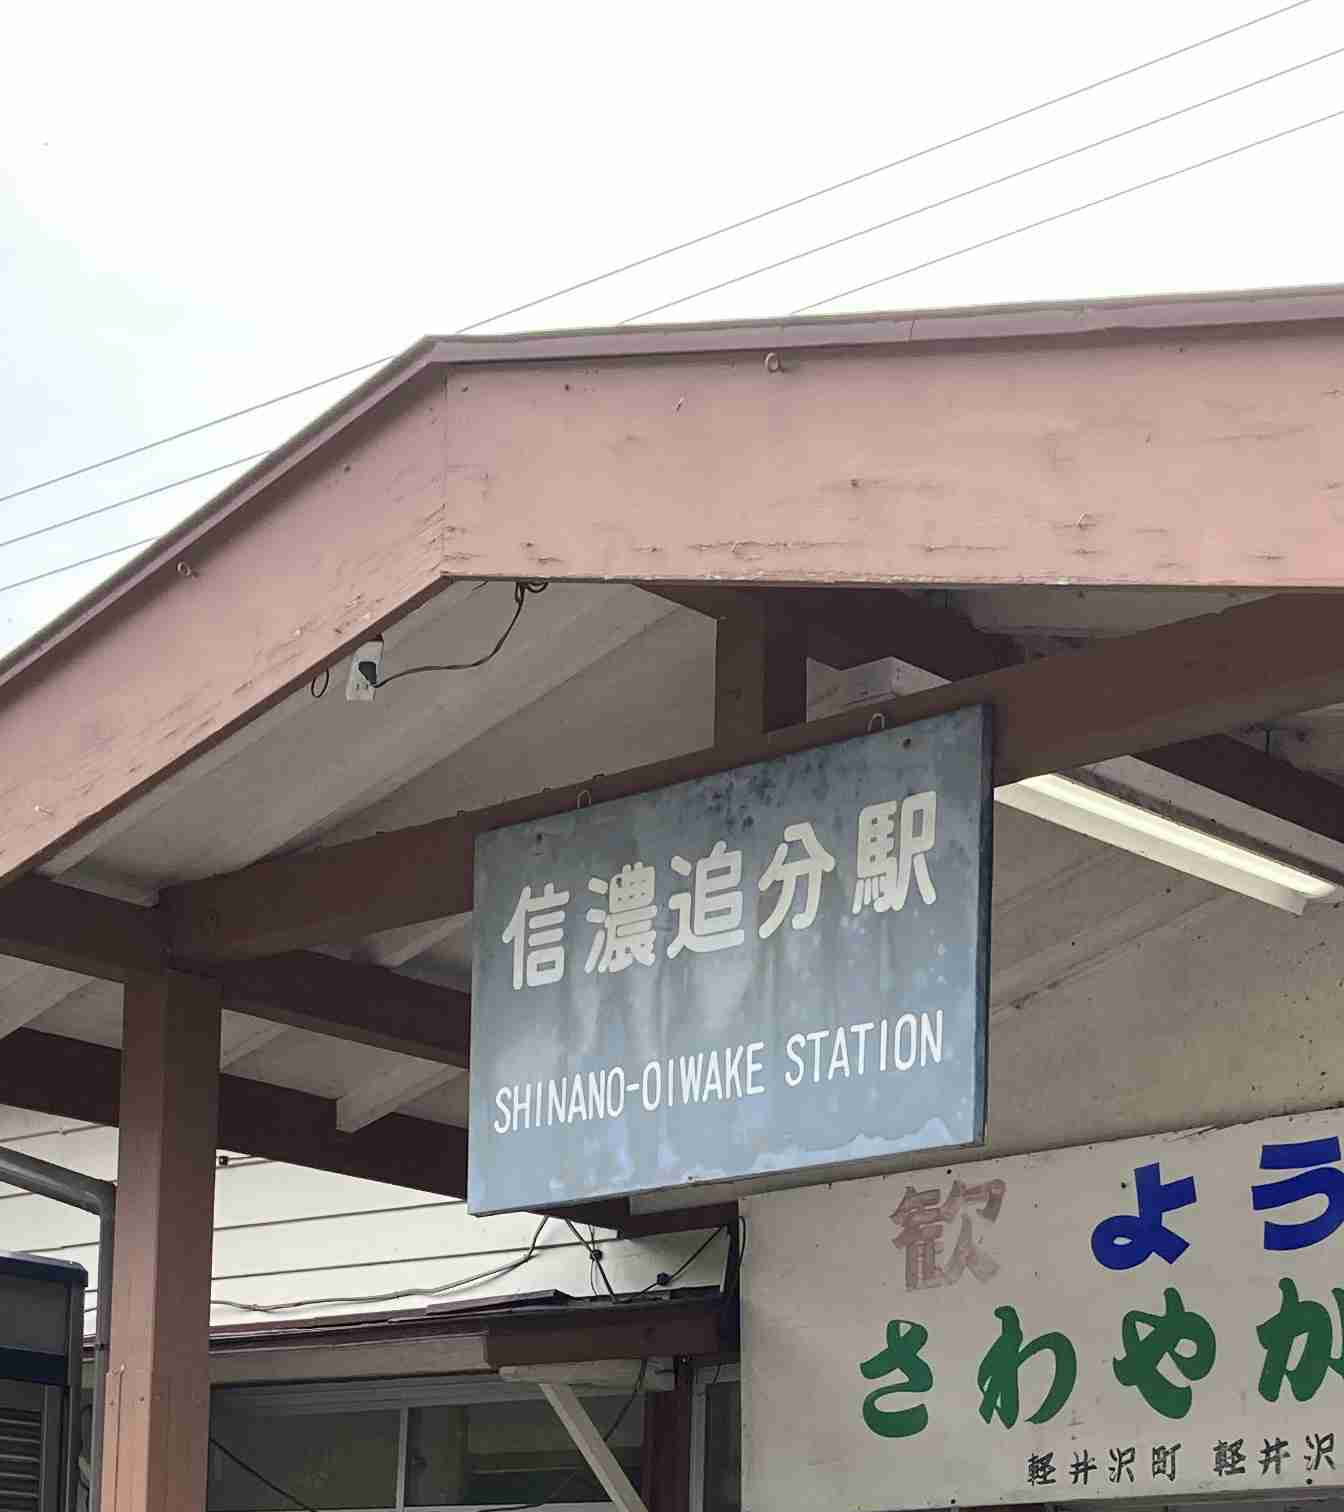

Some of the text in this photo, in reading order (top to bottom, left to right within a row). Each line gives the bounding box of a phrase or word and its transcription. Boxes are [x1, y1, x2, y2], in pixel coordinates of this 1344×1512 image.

[502, 791, 937, 990] 信濃追分駅
[494, 1009, 944, 1135] SHINANO-OIWAKE STATION
[1026, 1442, 1182, 1487] 軽井沢町
